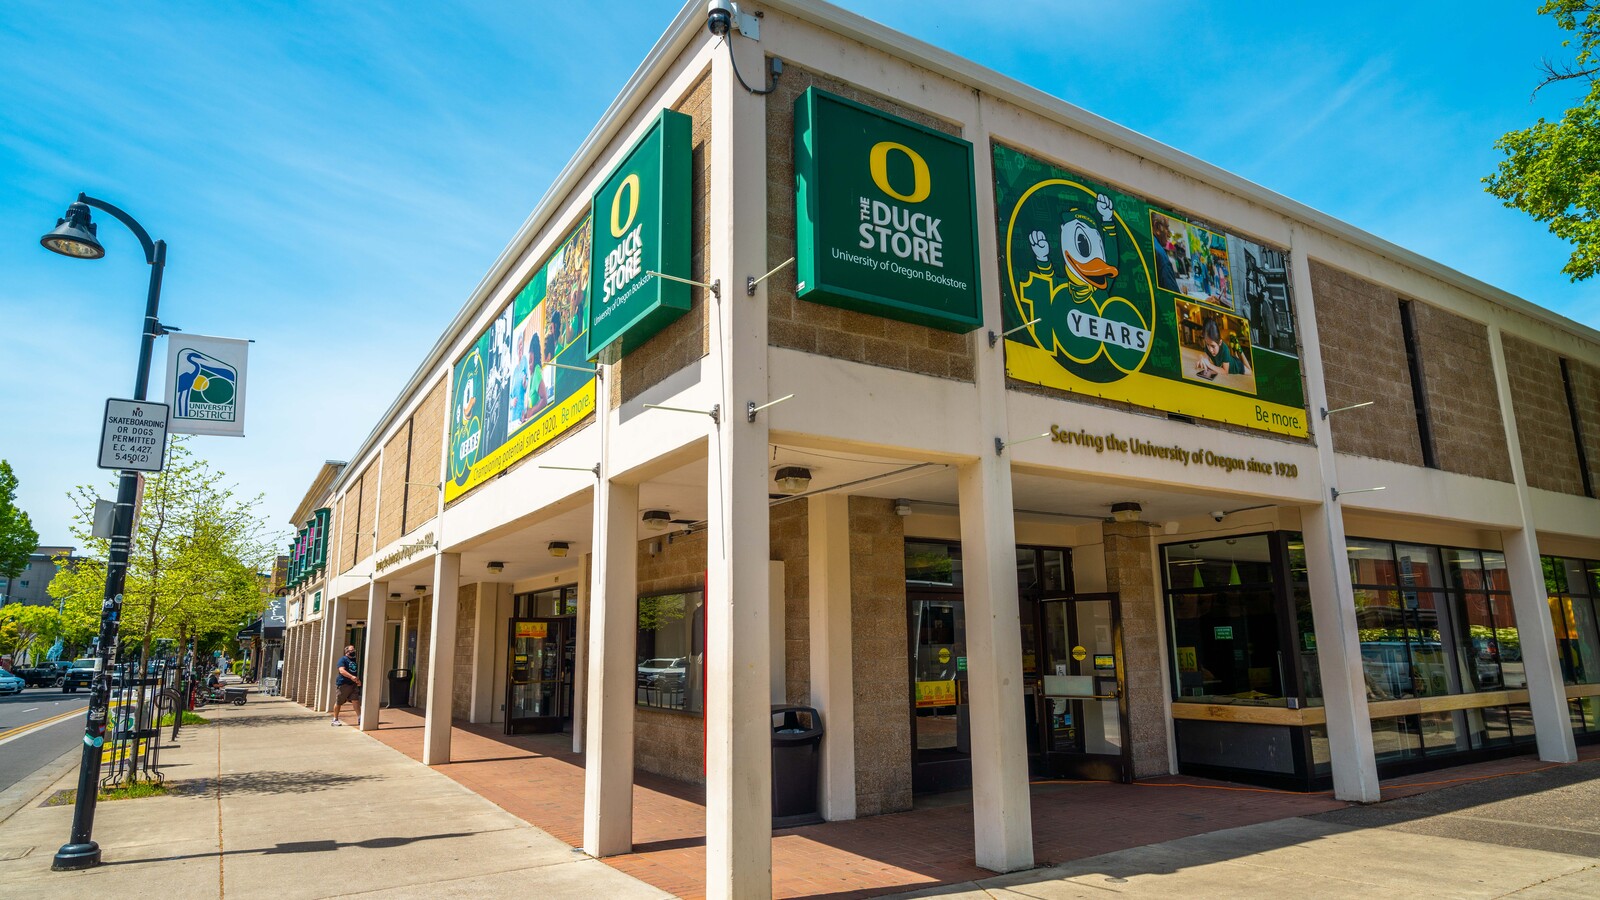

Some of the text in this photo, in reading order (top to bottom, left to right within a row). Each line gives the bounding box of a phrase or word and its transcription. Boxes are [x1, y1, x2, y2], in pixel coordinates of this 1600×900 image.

[870, 142, 930, 203] O
[611, 174, 639, 238] O
[860, 197, 942, 242] THE DUCK
[610, 223, 642, 275] DUCK
[859, 223, 943, 268] STORE
[603, 248, 641, 302] STORE
[832, 248, 967, 290] University of Oregon Bookstore
[617, 289, 631, 306] Oregon
[1072, 313, 1145, 348] YEARS
[109, 417, 164, 428] SKATEBOARDING
[189, 410, 233, 419] DISTRICT
[190, 403, 233, 411] UNIVERSITY
[1256, 405, 1302, 429] Be more.
[112, 435, 155, 444] PERMITTED
[118, 426, 153, 436] OR DOGS
[473, 394, 590, 480] Championing potential since 1920. Be more.
[115, 453, 148, 462] 5.450(2)
[1050, 424, 1298, 478] Serving the University of Oregon since 1920
[1186, 652, 1194, 667] IS
